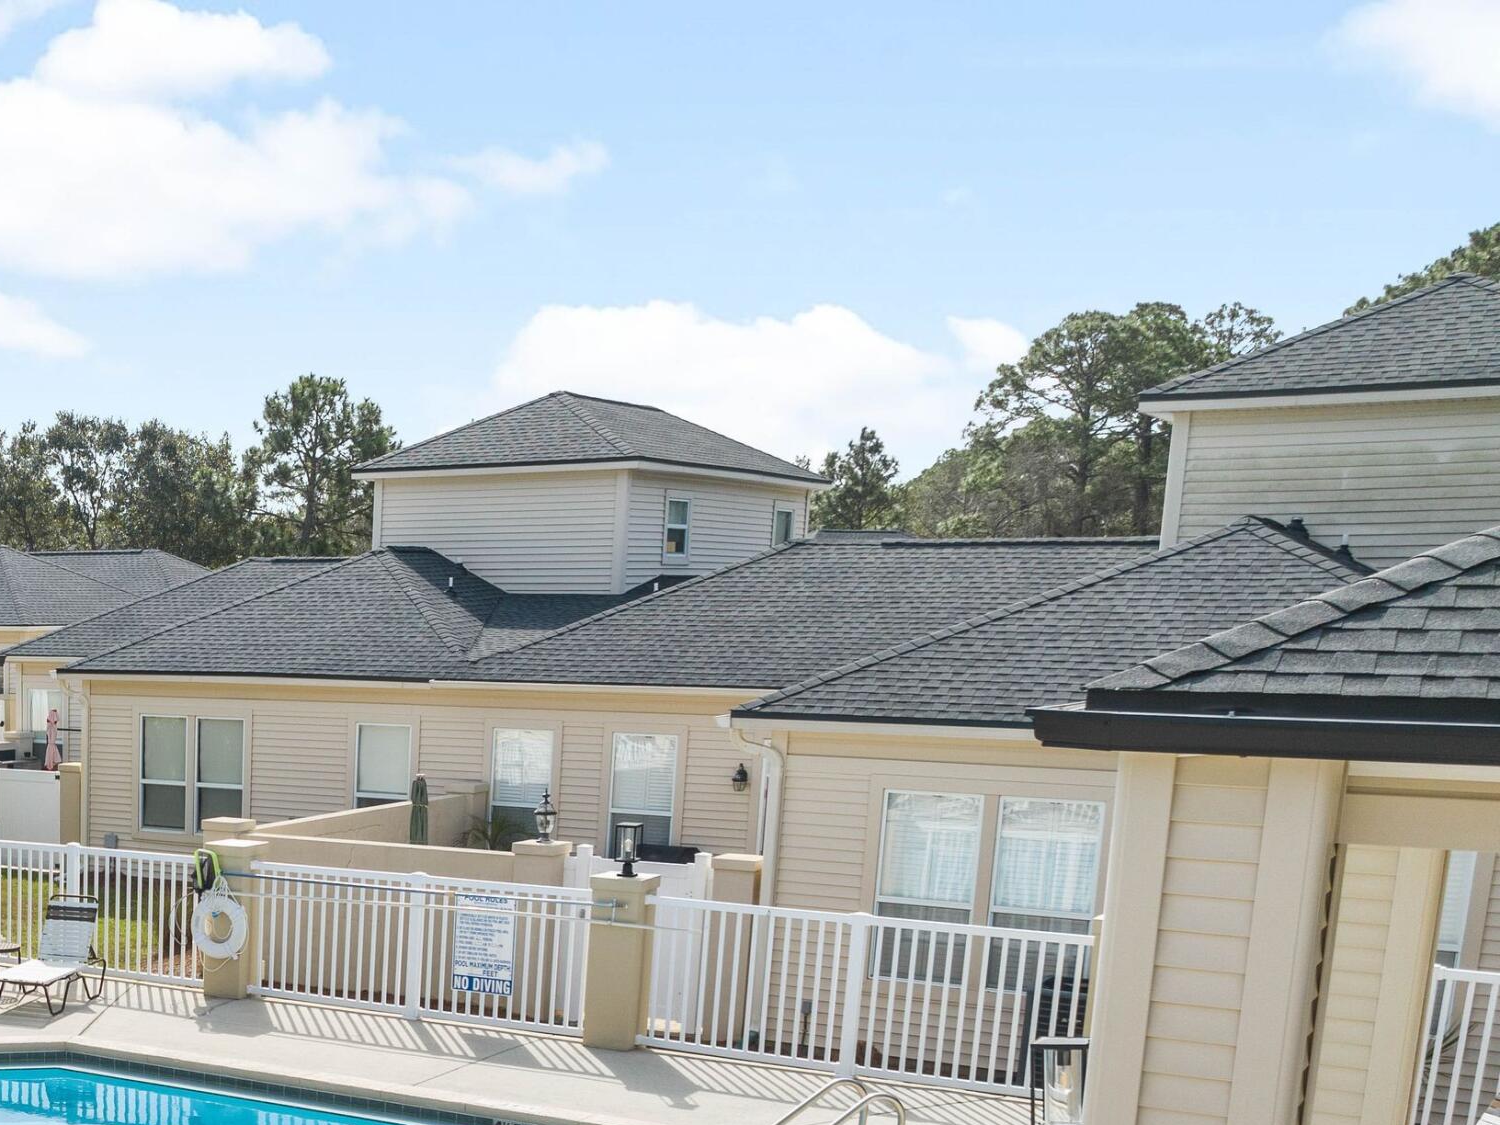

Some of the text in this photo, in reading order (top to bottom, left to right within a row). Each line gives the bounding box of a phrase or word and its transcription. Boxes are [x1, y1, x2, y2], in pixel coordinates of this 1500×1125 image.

[454, 960, 468, 968] POOL
[469, 962, 493, 970] MAXIMUM
[454, 975, 511, 995] NO DIVING
